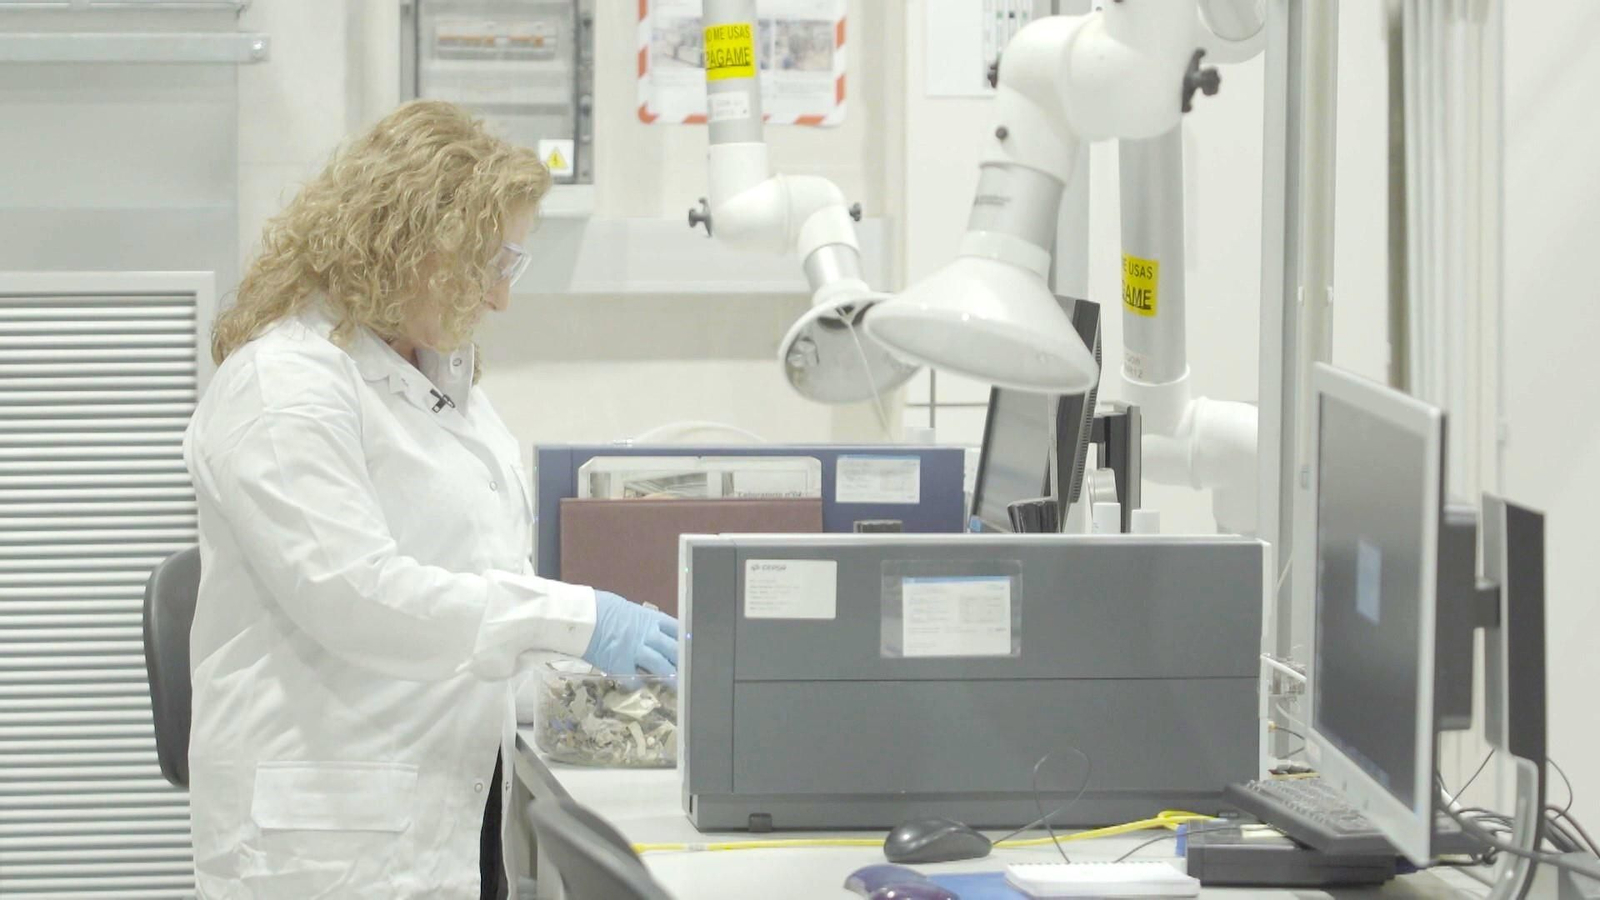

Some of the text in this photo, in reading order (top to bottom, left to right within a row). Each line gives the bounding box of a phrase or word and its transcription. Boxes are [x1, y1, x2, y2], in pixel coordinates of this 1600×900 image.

[713, 27, 725, 40] ME
[727, 25, 750, 40] USAS
[1128, 261, 1153, 280] USAS
